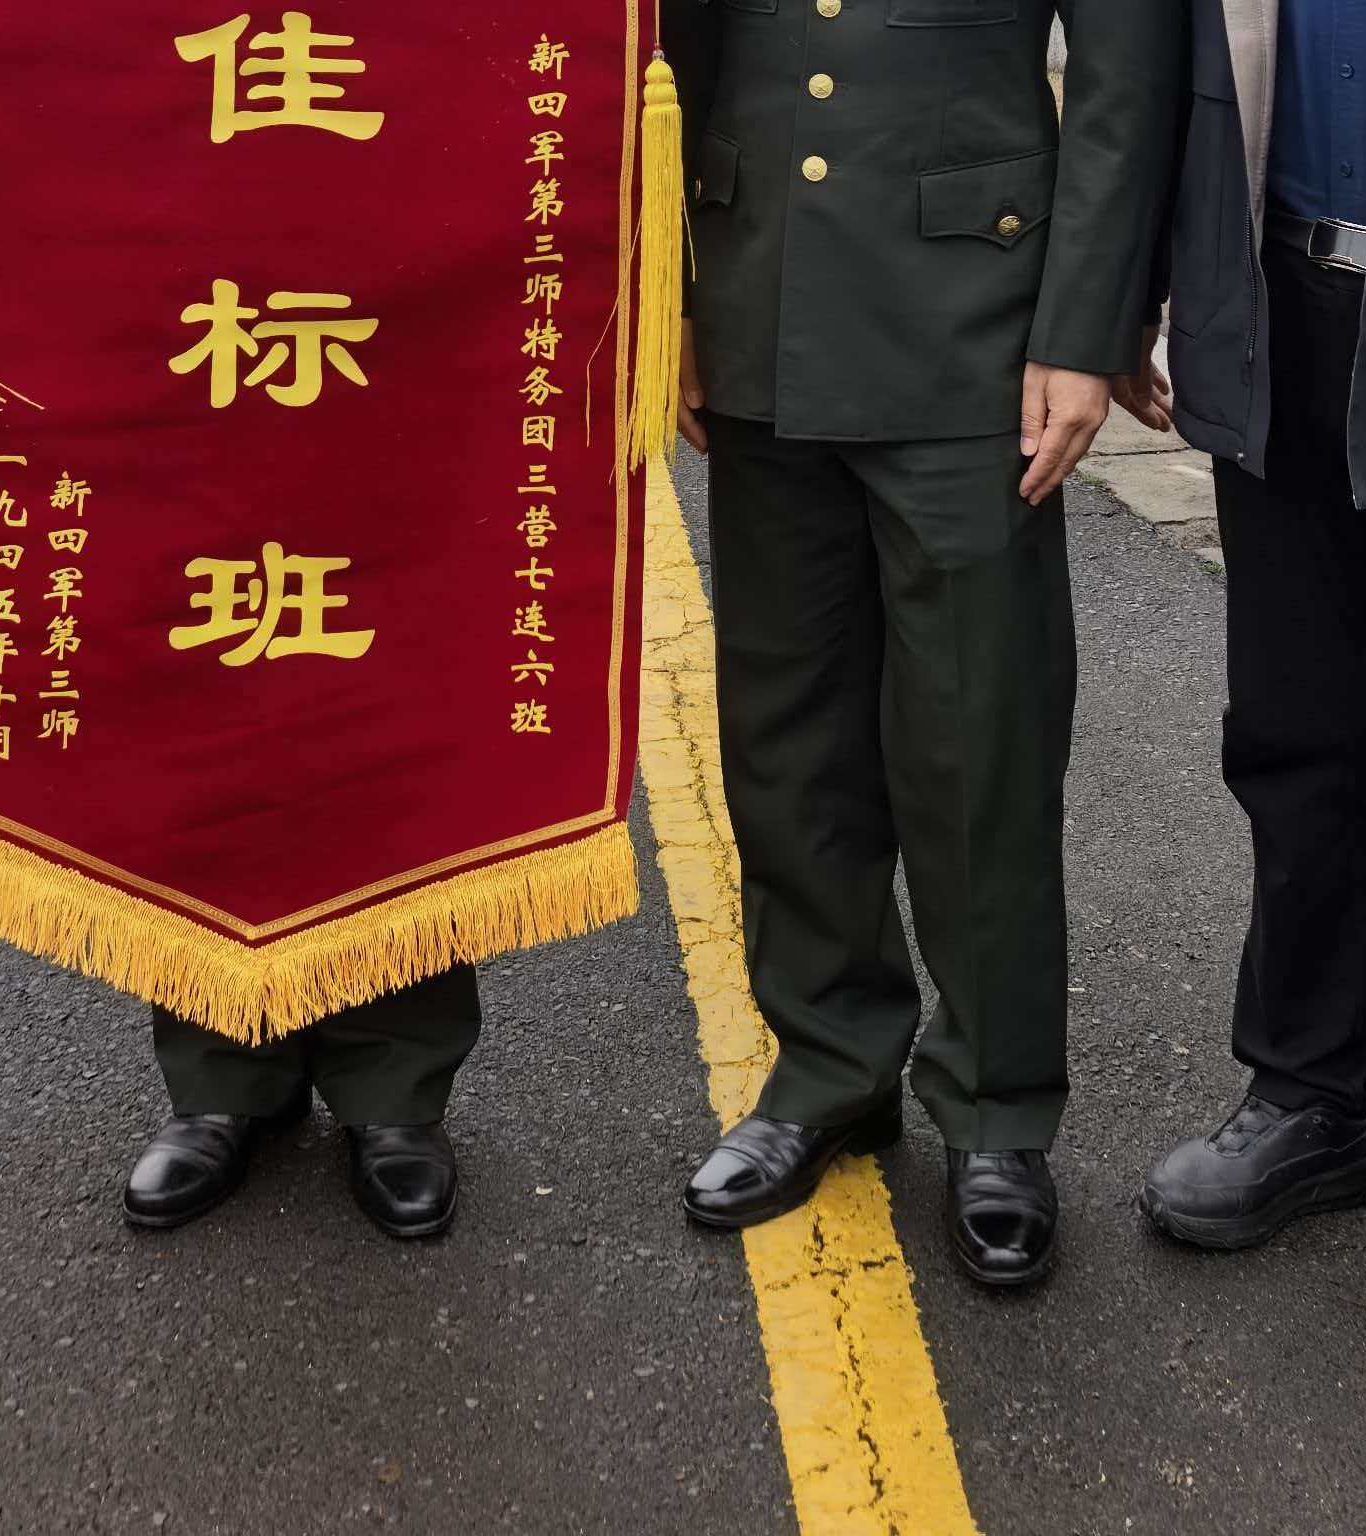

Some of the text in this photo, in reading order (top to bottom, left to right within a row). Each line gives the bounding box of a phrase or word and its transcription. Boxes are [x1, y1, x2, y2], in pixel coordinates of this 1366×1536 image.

[168, 11, 385, 667] 佳标班
[36, 470, 92, 750] 新四军第三师
